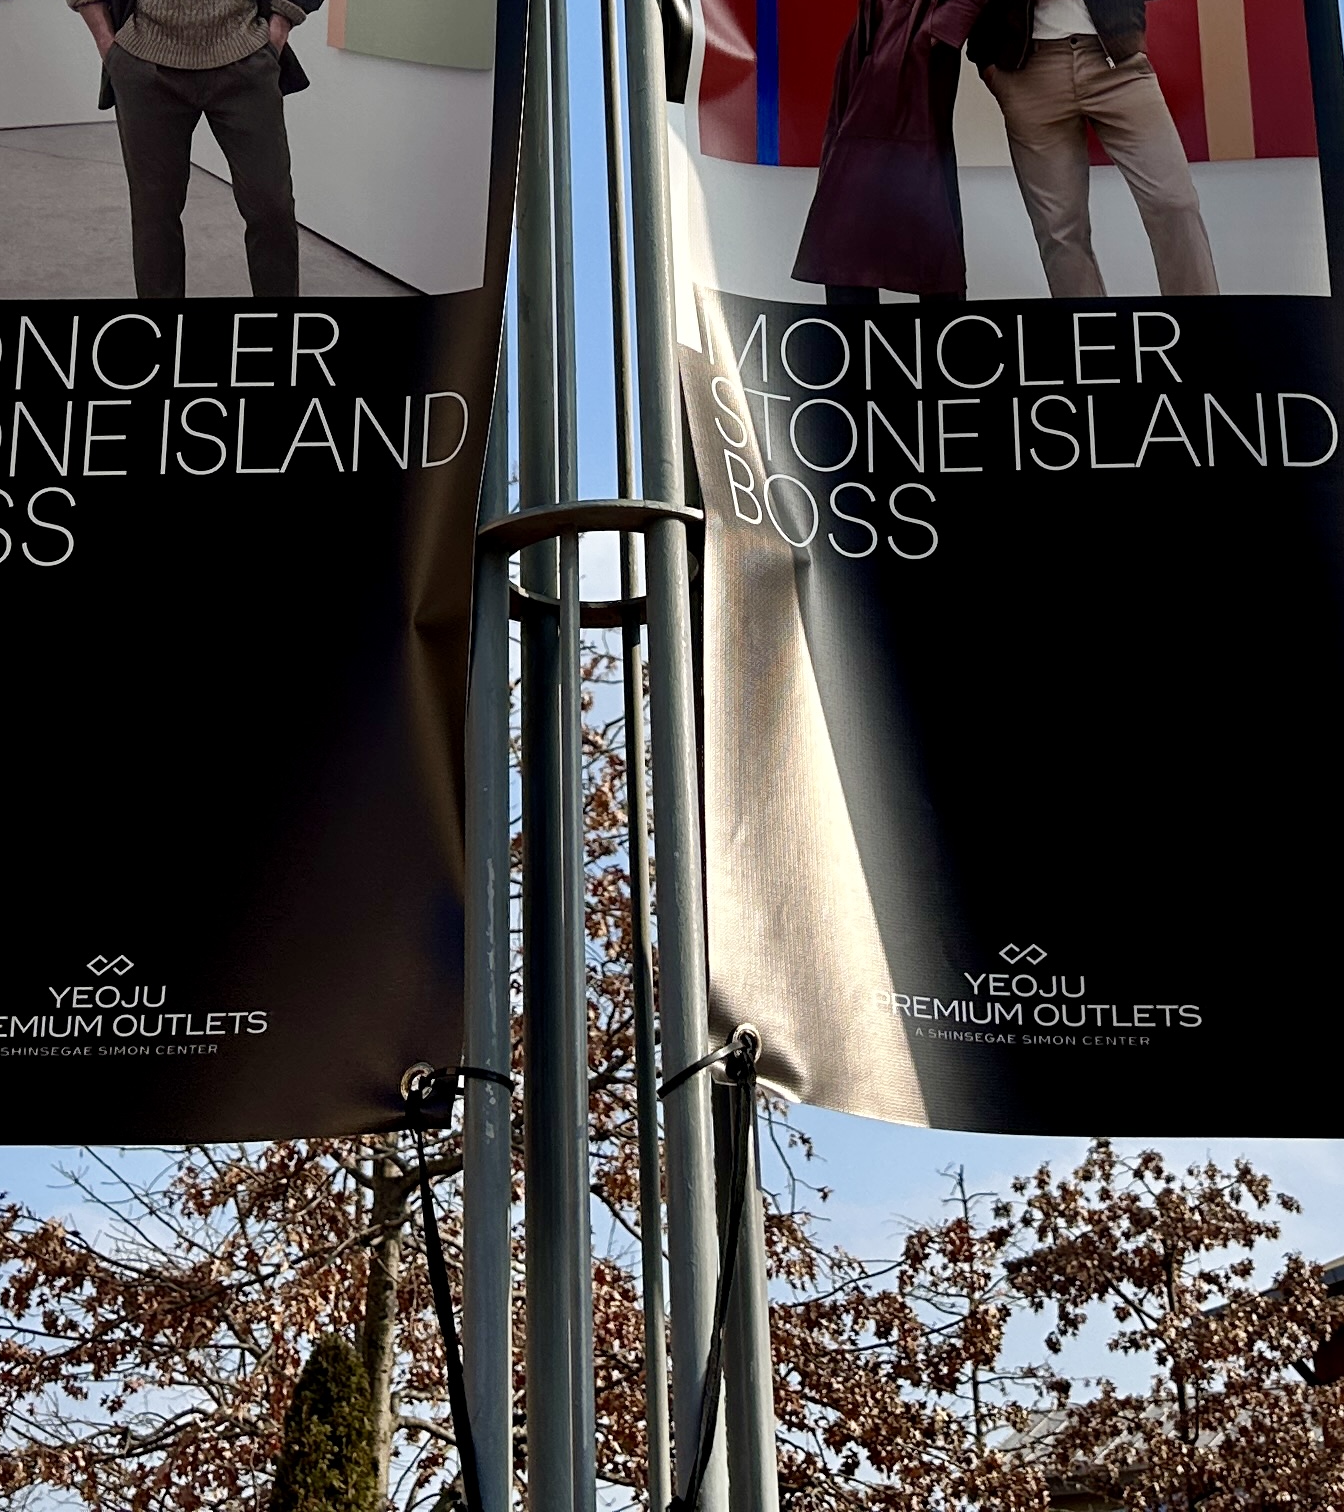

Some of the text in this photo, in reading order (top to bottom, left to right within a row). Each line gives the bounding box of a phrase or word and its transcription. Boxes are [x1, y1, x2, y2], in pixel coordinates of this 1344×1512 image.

[700, 310, 1183, 390] MONCLER
[159, 391, 469, 475] ISLAND
[711, 376, 1339, 473] STONE ISLAND
[723, 448, 939, 559] BOSS
[48, 985, 167, 1009] YEOJU
[963, 971, 1086, 998] YEOJU
[112, 1010, 269, 1037] OUTLETS
[1033, 1003, 1203, 1027] OUTLETS
[0, 1045, 93, 1057] SHINSEGAE
[98, 1045, 150, 1056] SIMON
[155, 1043, 218, 1056] CENTER
[914, 1027, 1152, 1047] A SHINSEGAE SIMON CENTER
